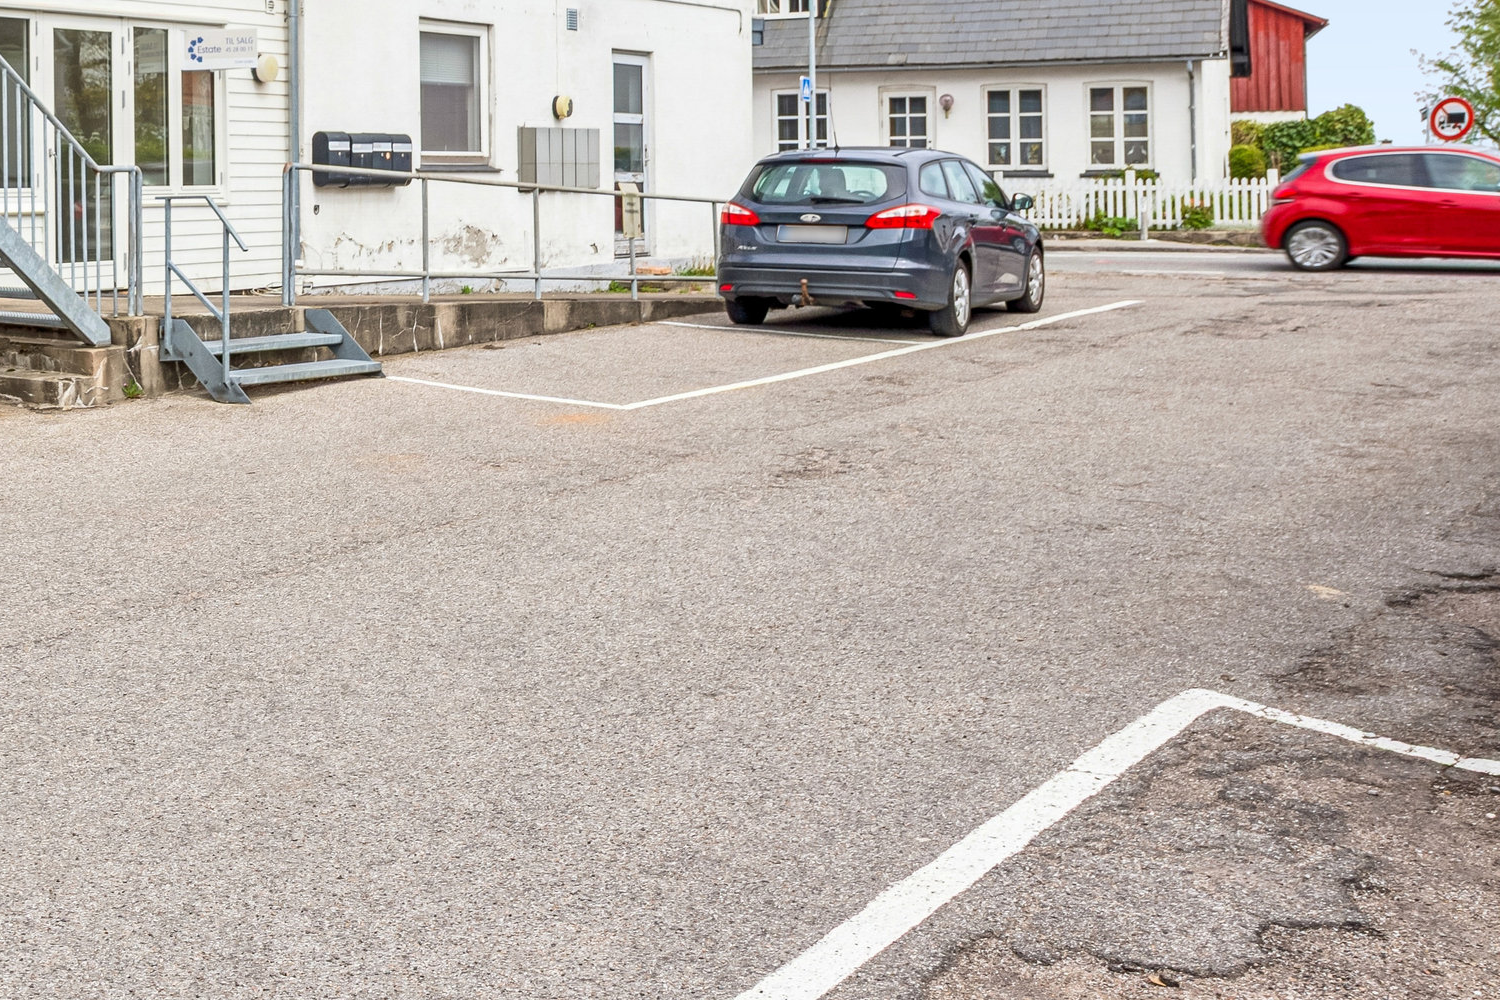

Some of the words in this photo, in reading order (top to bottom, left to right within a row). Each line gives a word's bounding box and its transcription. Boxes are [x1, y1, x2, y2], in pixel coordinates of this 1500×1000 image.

[225, 37, 234, 45] TIL
[236, 37, 253, 45] SALG
[197, 46, 222, 54] Estate
